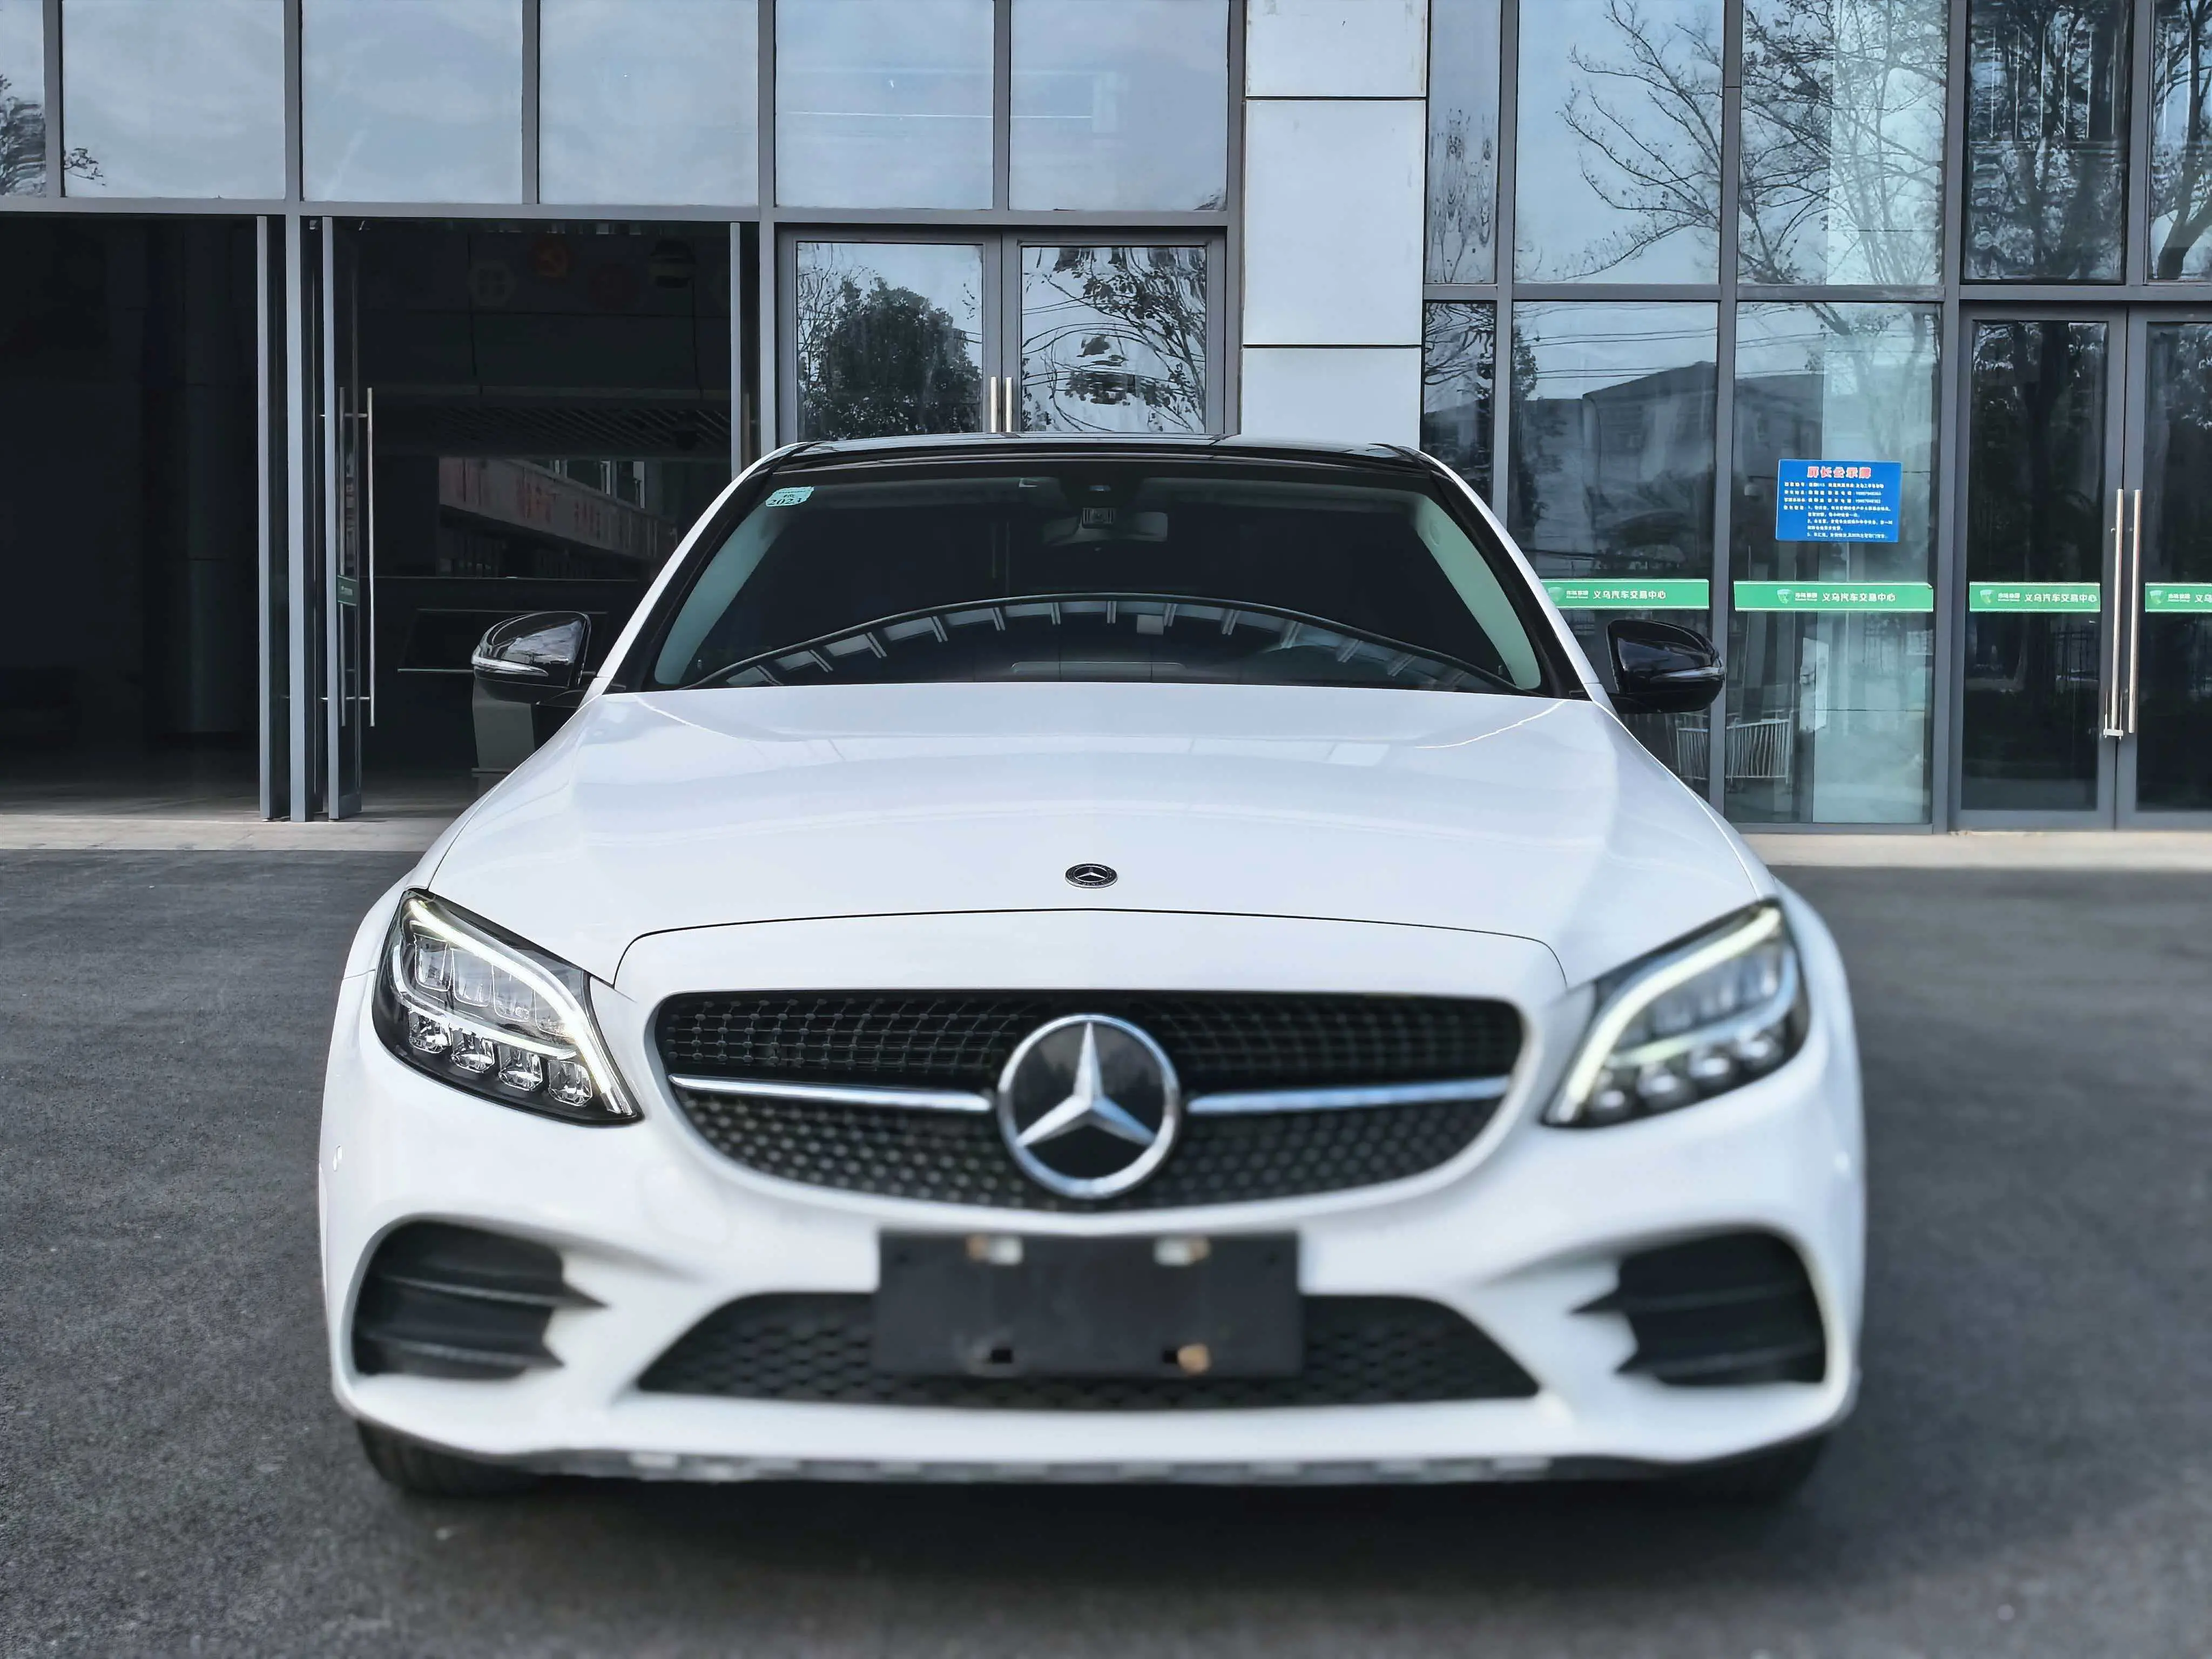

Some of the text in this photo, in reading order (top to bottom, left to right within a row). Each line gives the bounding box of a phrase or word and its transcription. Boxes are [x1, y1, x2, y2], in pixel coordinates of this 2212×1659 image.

[1593, 590, 1667, 599] 义乌汽车交易中心
[1822, 592, 1896, 602] 义乌汽车交易中心
[2024, 593, 2098, 603] 义乌汽车交易中心
